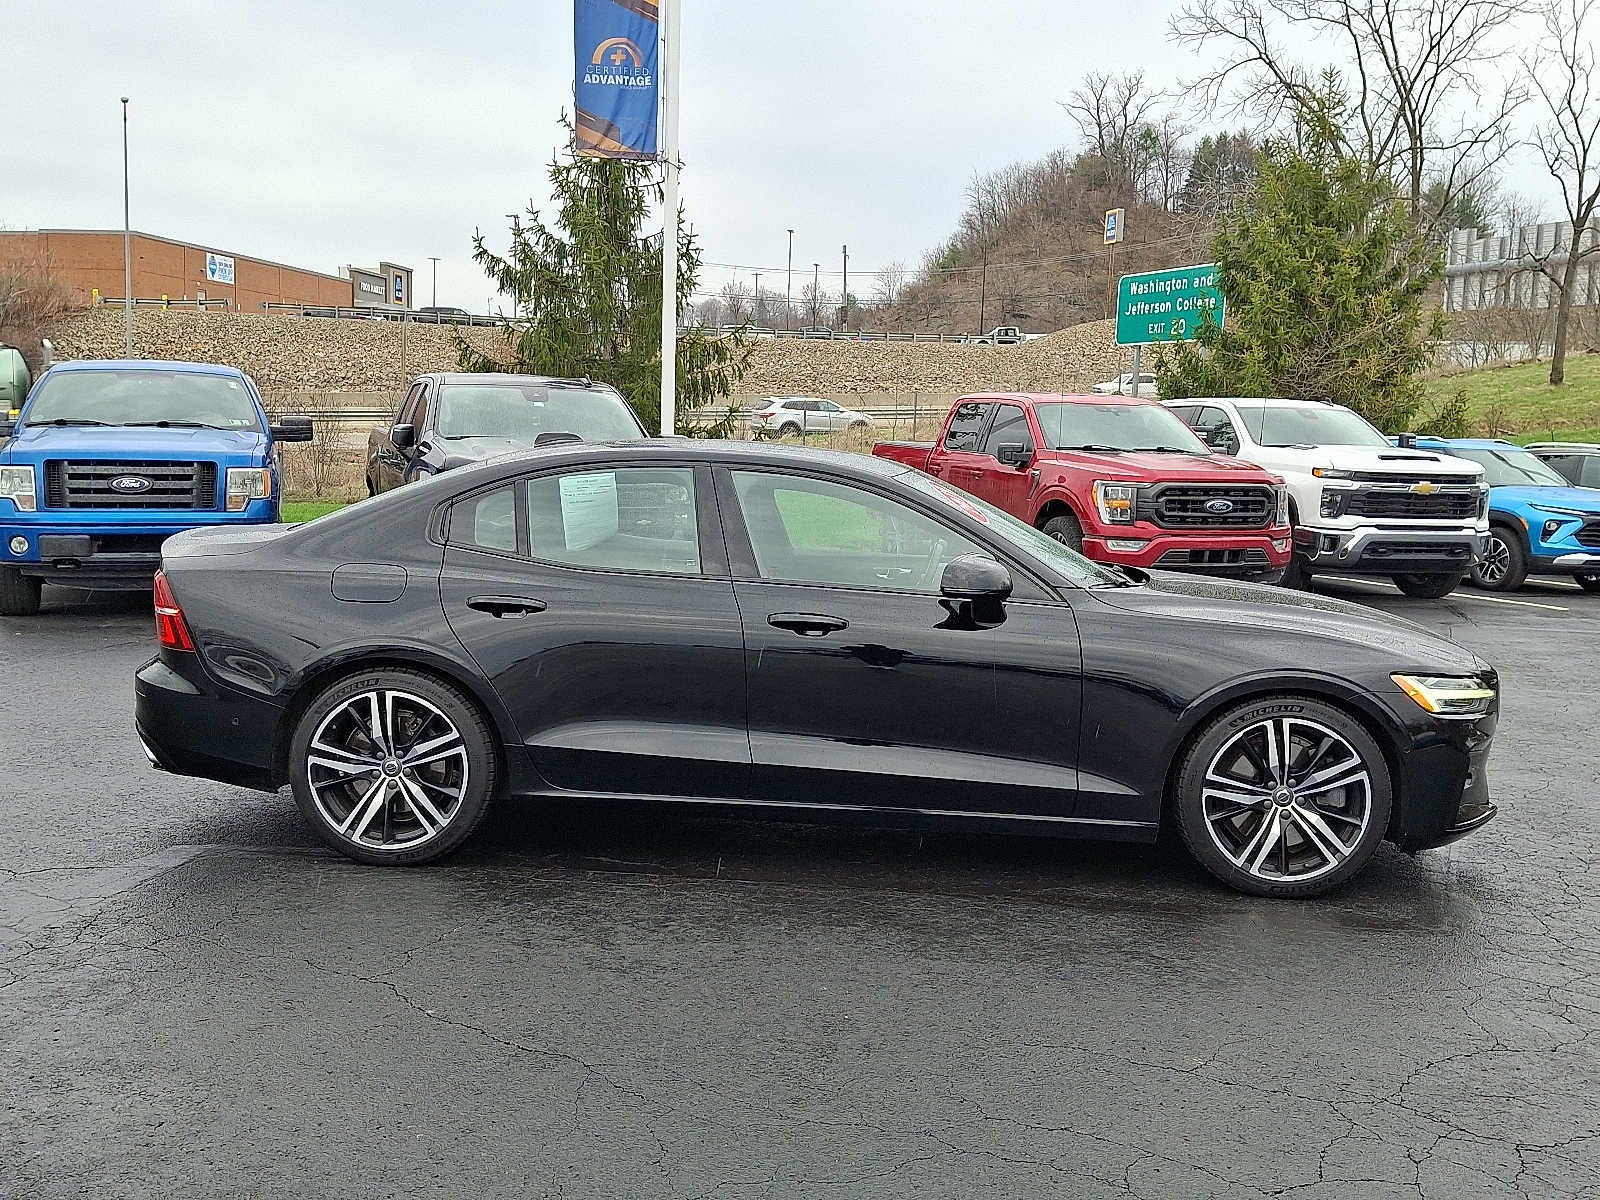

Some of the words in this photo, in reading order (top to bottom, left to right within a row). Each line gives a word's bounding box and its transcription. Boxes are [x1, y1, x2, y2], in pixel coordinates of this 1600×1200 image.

[586, 65, 649, 75] CERTIFIED
[583, 73, 652, 86] ADVANTAGE
[1130, 278, 1188, 295] Washington
[1193, 272, 1214, 288] and
[1125, 301, 1172, 316] Jefferson
[1148, 323, 1166, 334] EXIT
[1170, 319, 1186, 335] 20
[1243, 705, 1302, 721] MICHELIN
